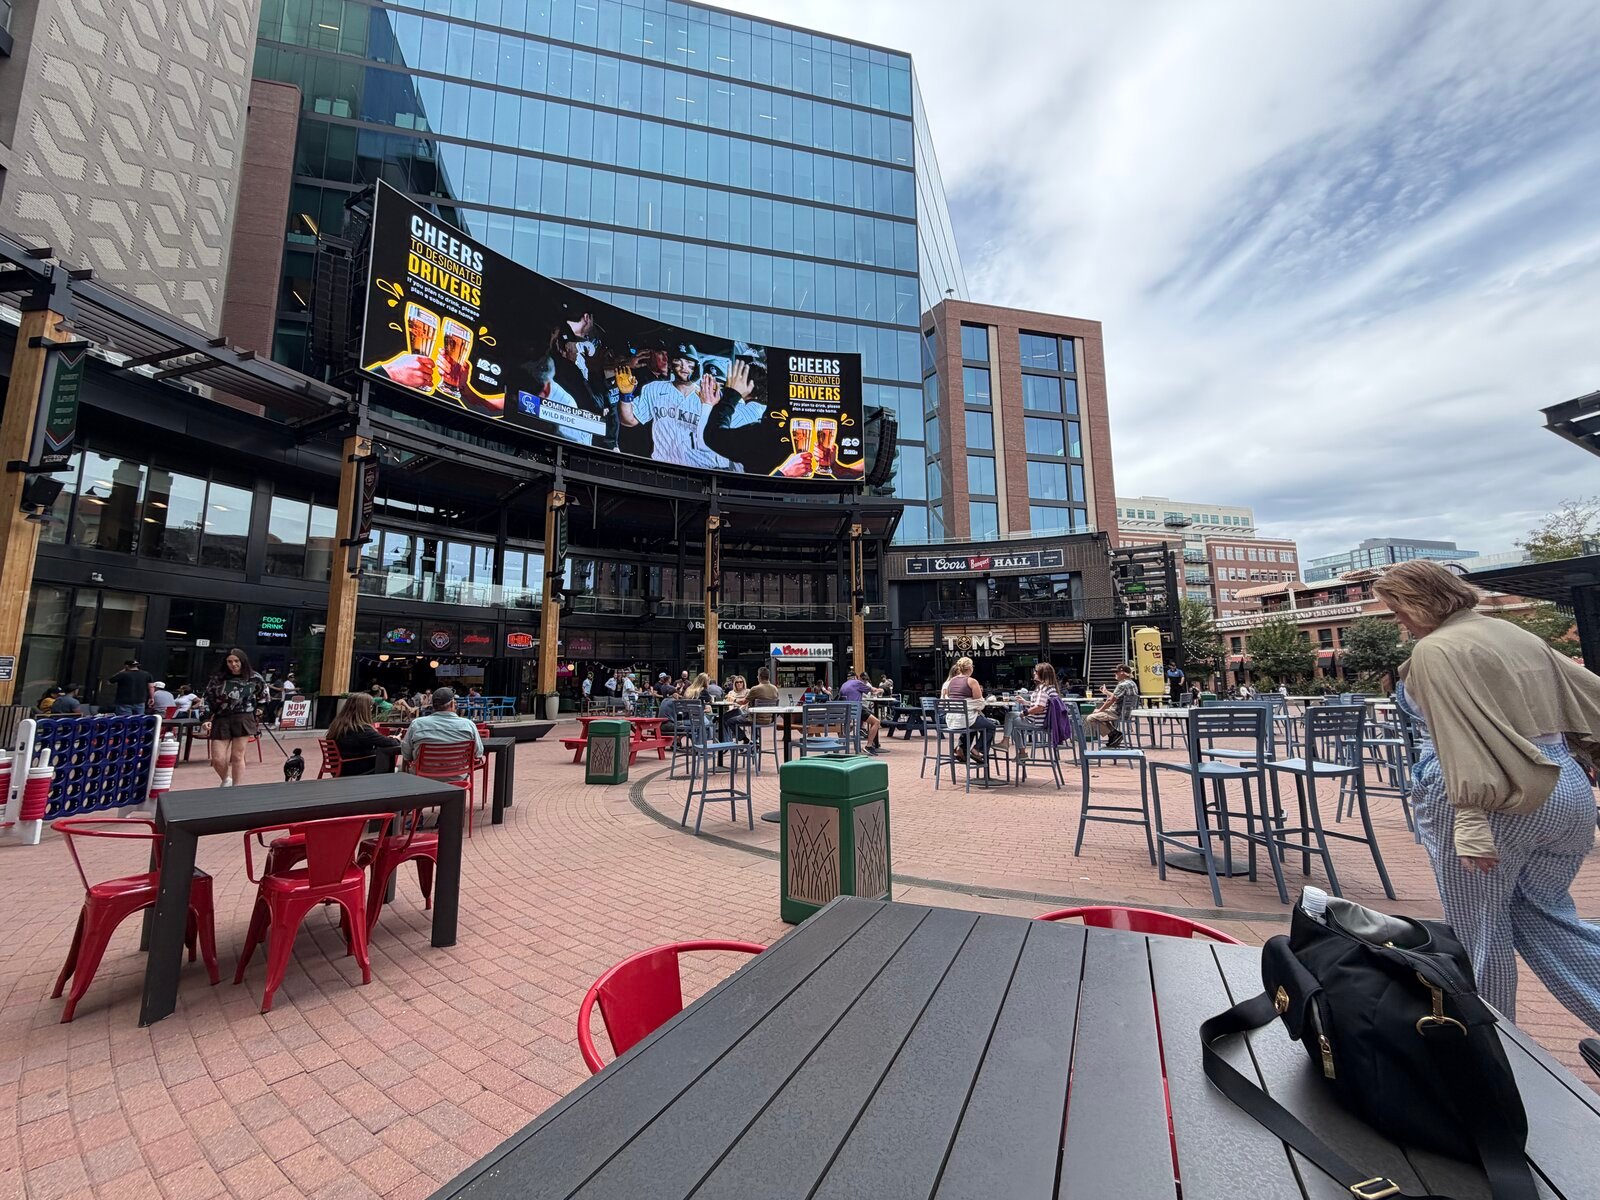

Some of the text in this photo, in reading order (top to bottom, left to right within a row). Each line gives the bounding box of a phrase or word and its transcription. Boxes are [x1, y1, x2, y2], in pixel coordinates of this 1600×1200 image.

[411, 214, 484, 272] CHEERS
[411, 240, 482, 286] TO DESIGNATED
[408, 252, 481, 306] DRIVERS
[410, 286, 424, 298] plan
[429, 296, 446, 308] sober
[446, 304, 458, 314] ride
[412, 280, 424, 290] you
[424, 286, 437, 296] plan
[462, 305, 480, 318] please
[788, 356, 840, 374] CHEERS
[790, 374, 840, 385] TO DESIGNATED
[789, 384, 840, 401] DRIVERS
[541, 409, 576, 424] WILD RIDE
[542, 400, 602, 422] COMING UP NEXT
[652, 406, 701, 426] ROCKIE
[934, 558, 966, 570] Coors
[970, 558, 990, 570] Banquet
[994, 557, 1030, 568] HALL
[695, 622, 706, 630] Ba
[724, 622, 756, 630] Colorado
[782, 644, 832, 656] Coors LIGHT
[1144, 642, 1160, 652] Coo
